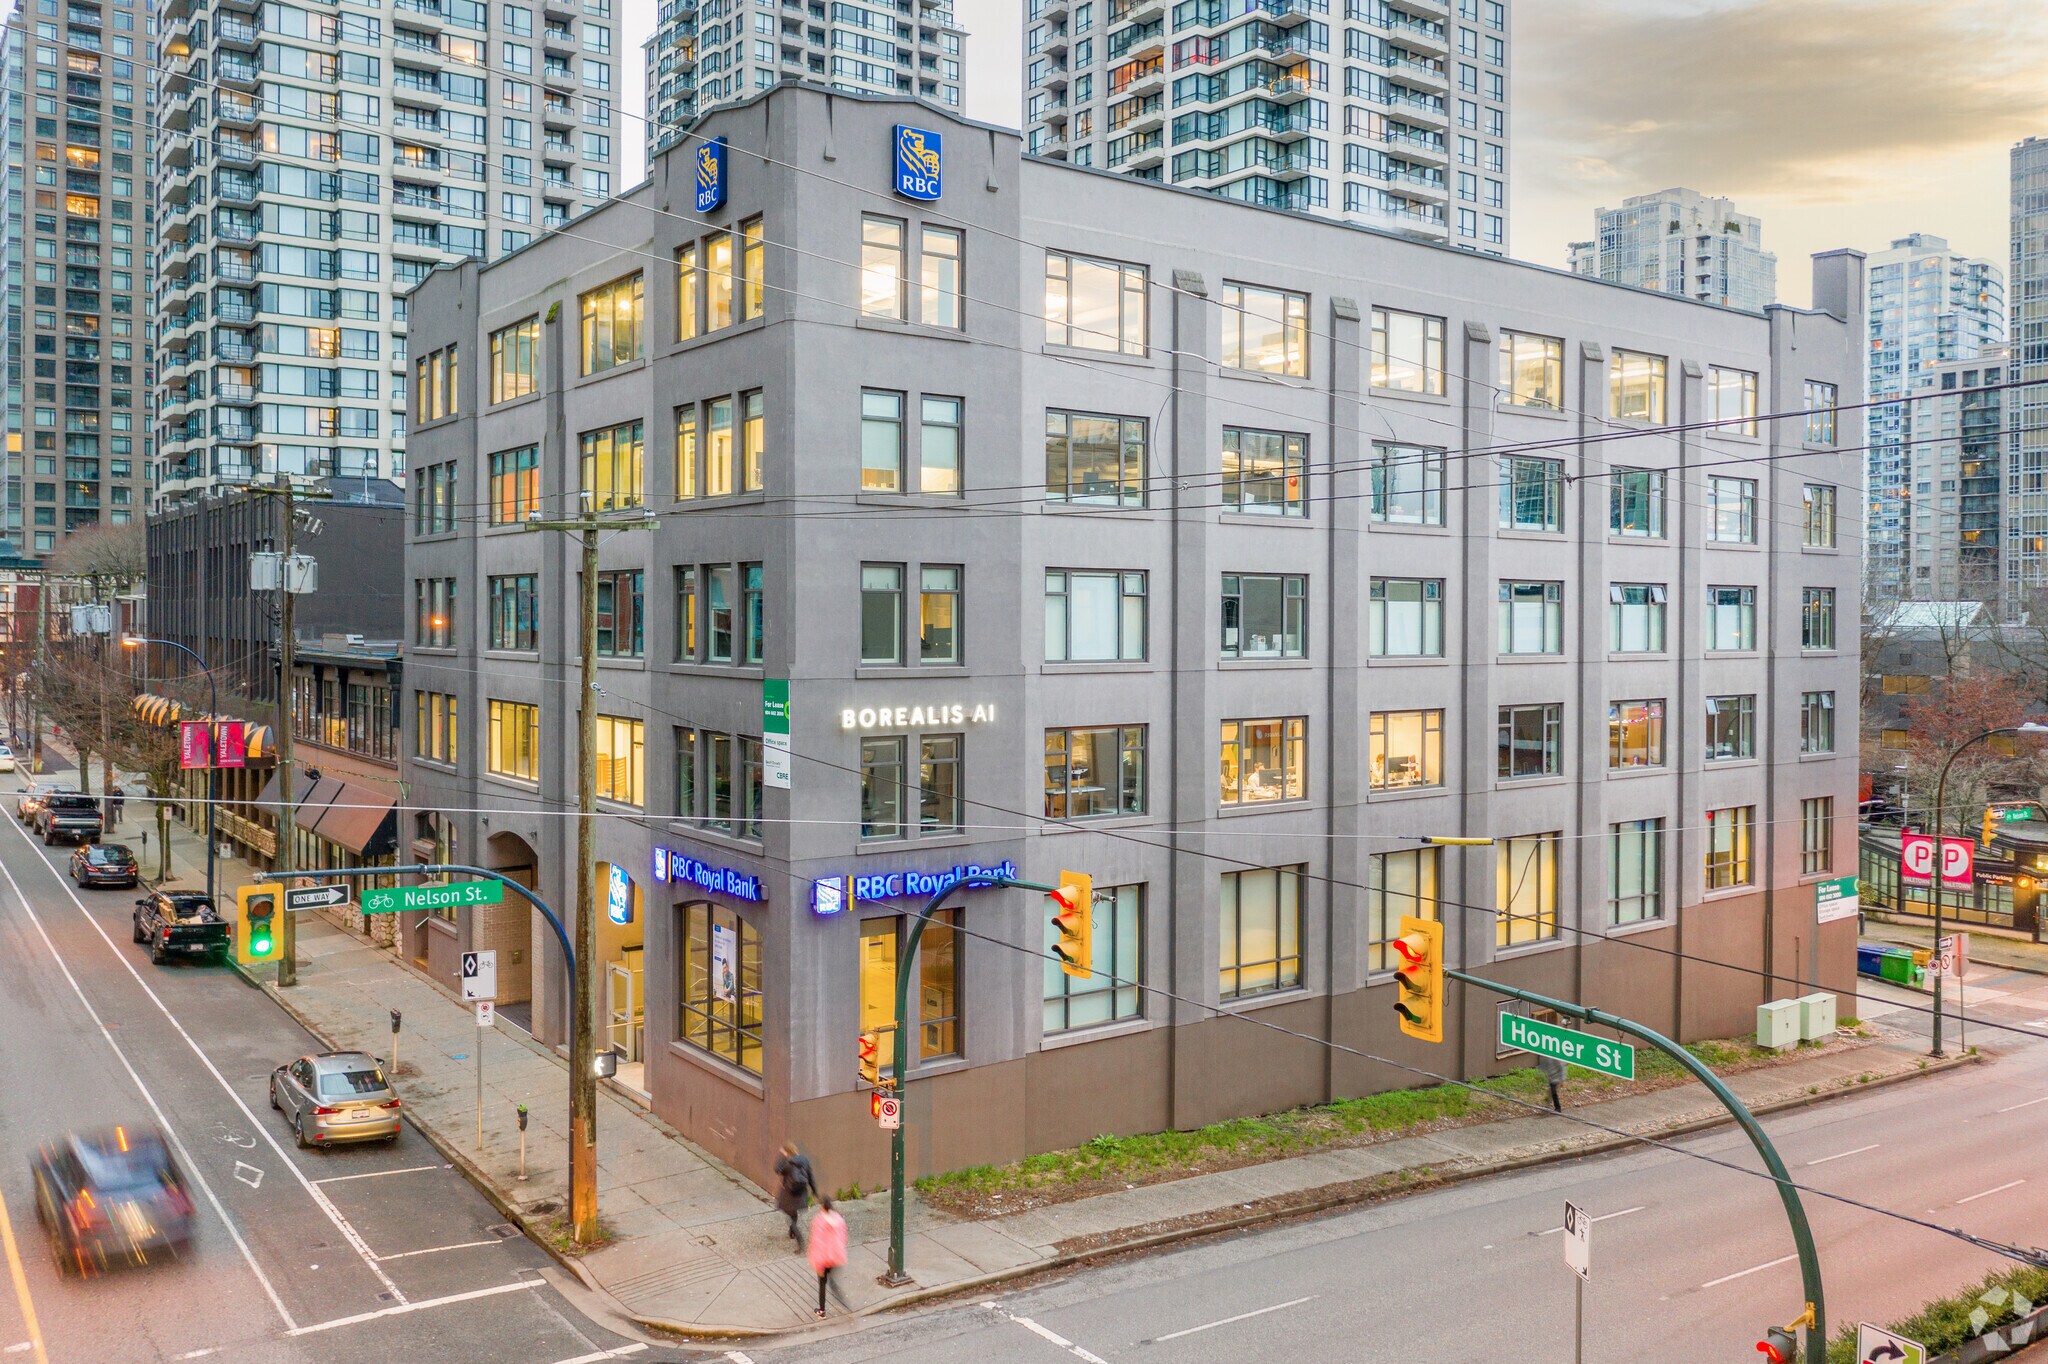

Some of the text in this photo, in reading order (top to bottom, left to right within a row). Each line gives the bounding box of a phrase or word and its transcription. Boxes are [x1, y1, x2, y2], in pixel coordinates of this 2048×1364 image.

[903, 175, 938, 195] RBC
[698, 187, 717, 208] RBC
[841, 703, 995, 728] BOREALIS AI
[220, 725, 228, 759] YALETOWN
[776, 772, 789, 780] CBRE
[1915, 845, 1929, 868] P
[1945, 848, 1959, 871] P
[671, 854, 757, 901] RBC Royal Bank
[856, 874, 900, 900] RBC
[907, 867, 961, 899] Royal
[1903, 876, 1930, 885] YALETOWN
[1943, 882, 1971, 890] YALETOWN
[1992, 874, 2013, 882] Parking
[294, 892, 330, 904] ONE WAY
[404, 886, 488, 907] Nelson St.
[819, 901, 839, 912] RBC
[1511, 1020, 1622, 1071] Homer St
